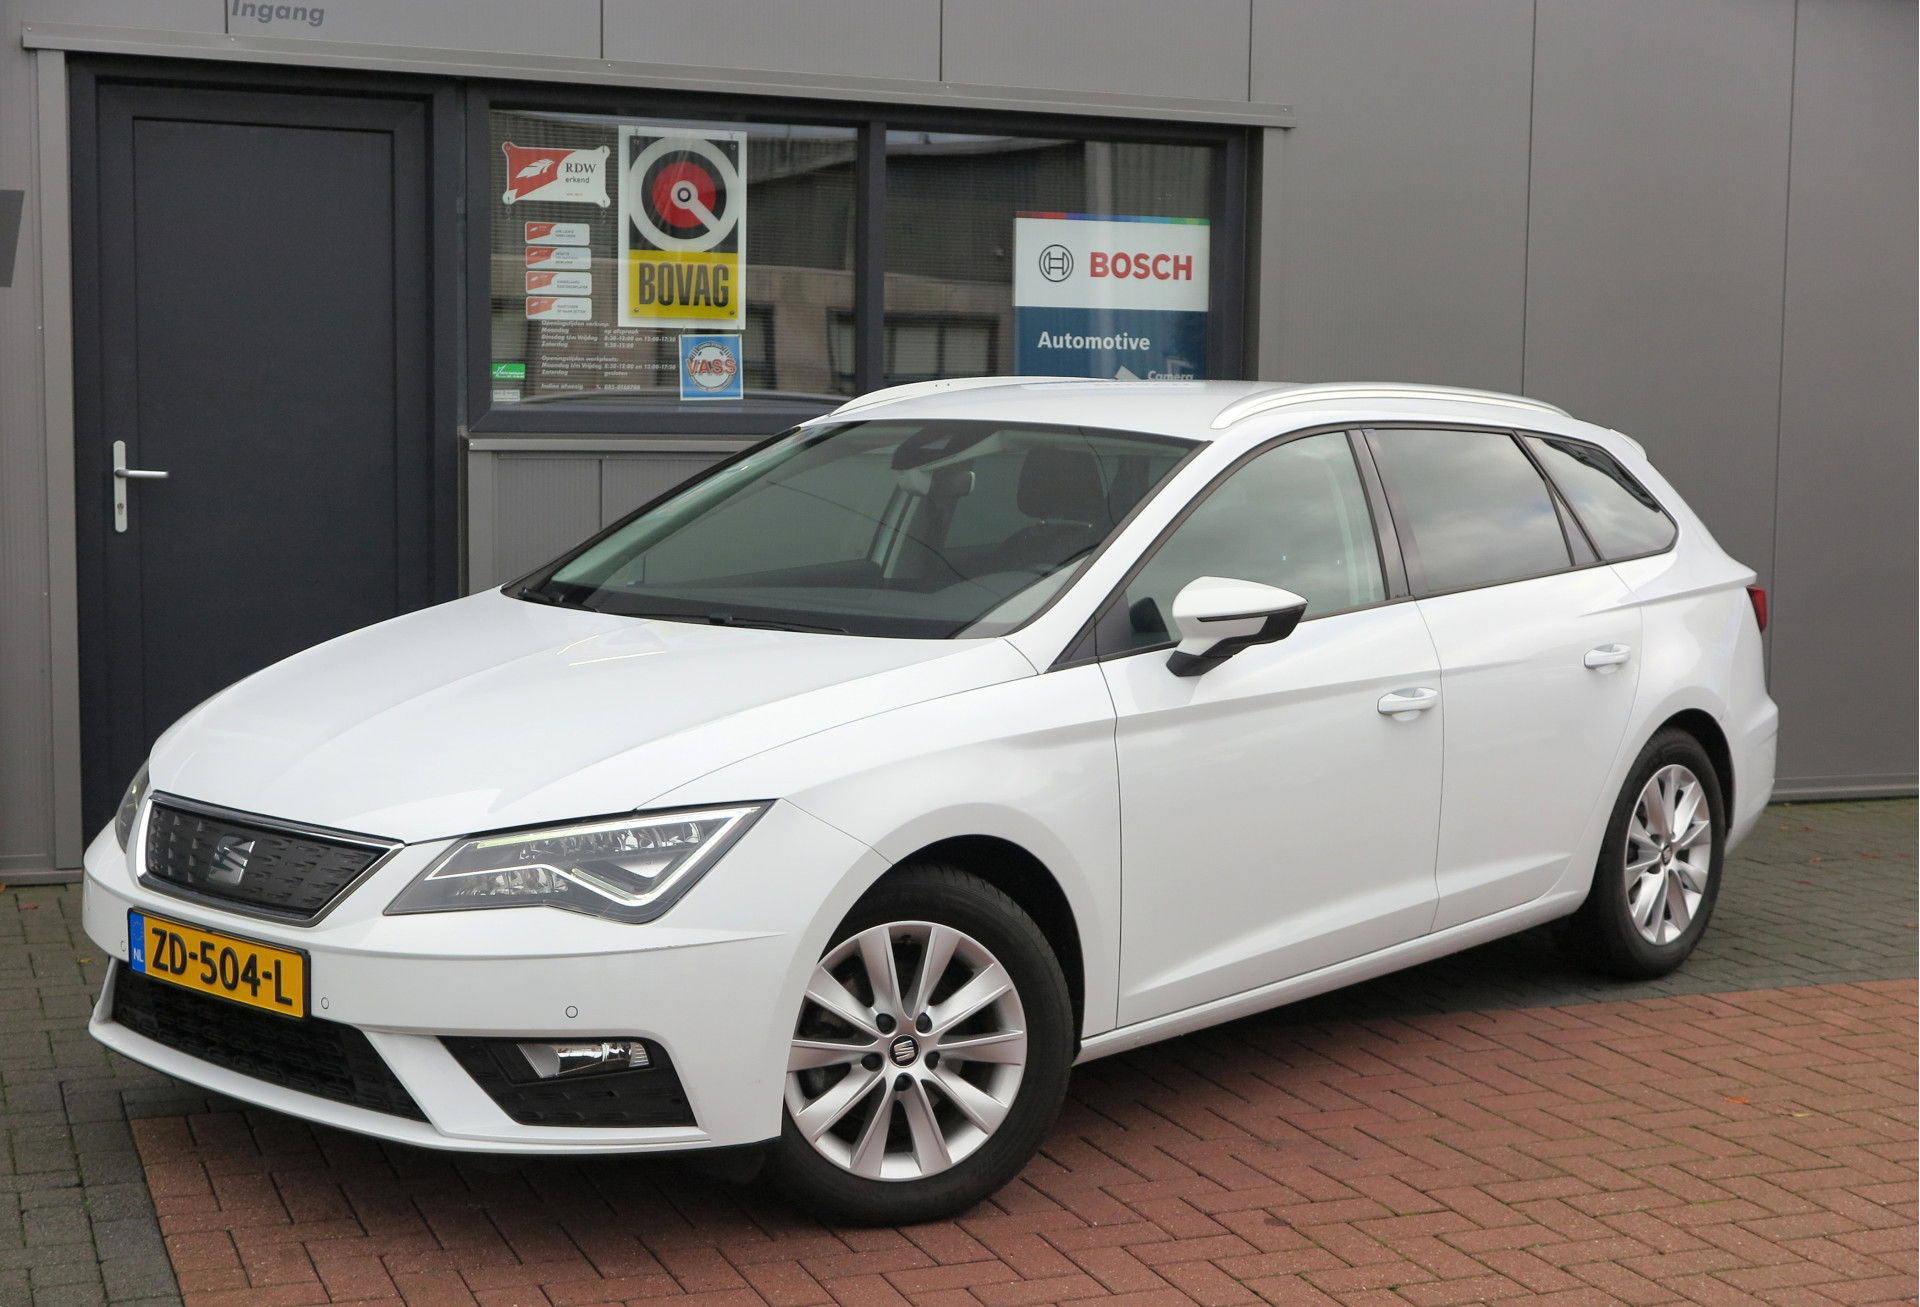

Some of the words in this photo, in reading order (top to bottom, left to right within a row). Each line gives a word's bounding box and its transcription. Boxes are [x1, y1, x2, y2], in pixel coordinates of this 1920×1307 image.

[232, 0, 325, 27] Ingang
[565, 163, 597, 173] RDW
[1090, 252, 1192, 280] BOSCH
[638, 262, 729, 308] BOVAG
[1037, 331, 1150, 350] Automotive
[685, 359, 737, 376] VASS
[1148, 370, 1194, 380] Camera
[133, 947, 144, 962] NL
[152, 927, 293, 1006] ZD-504-L
